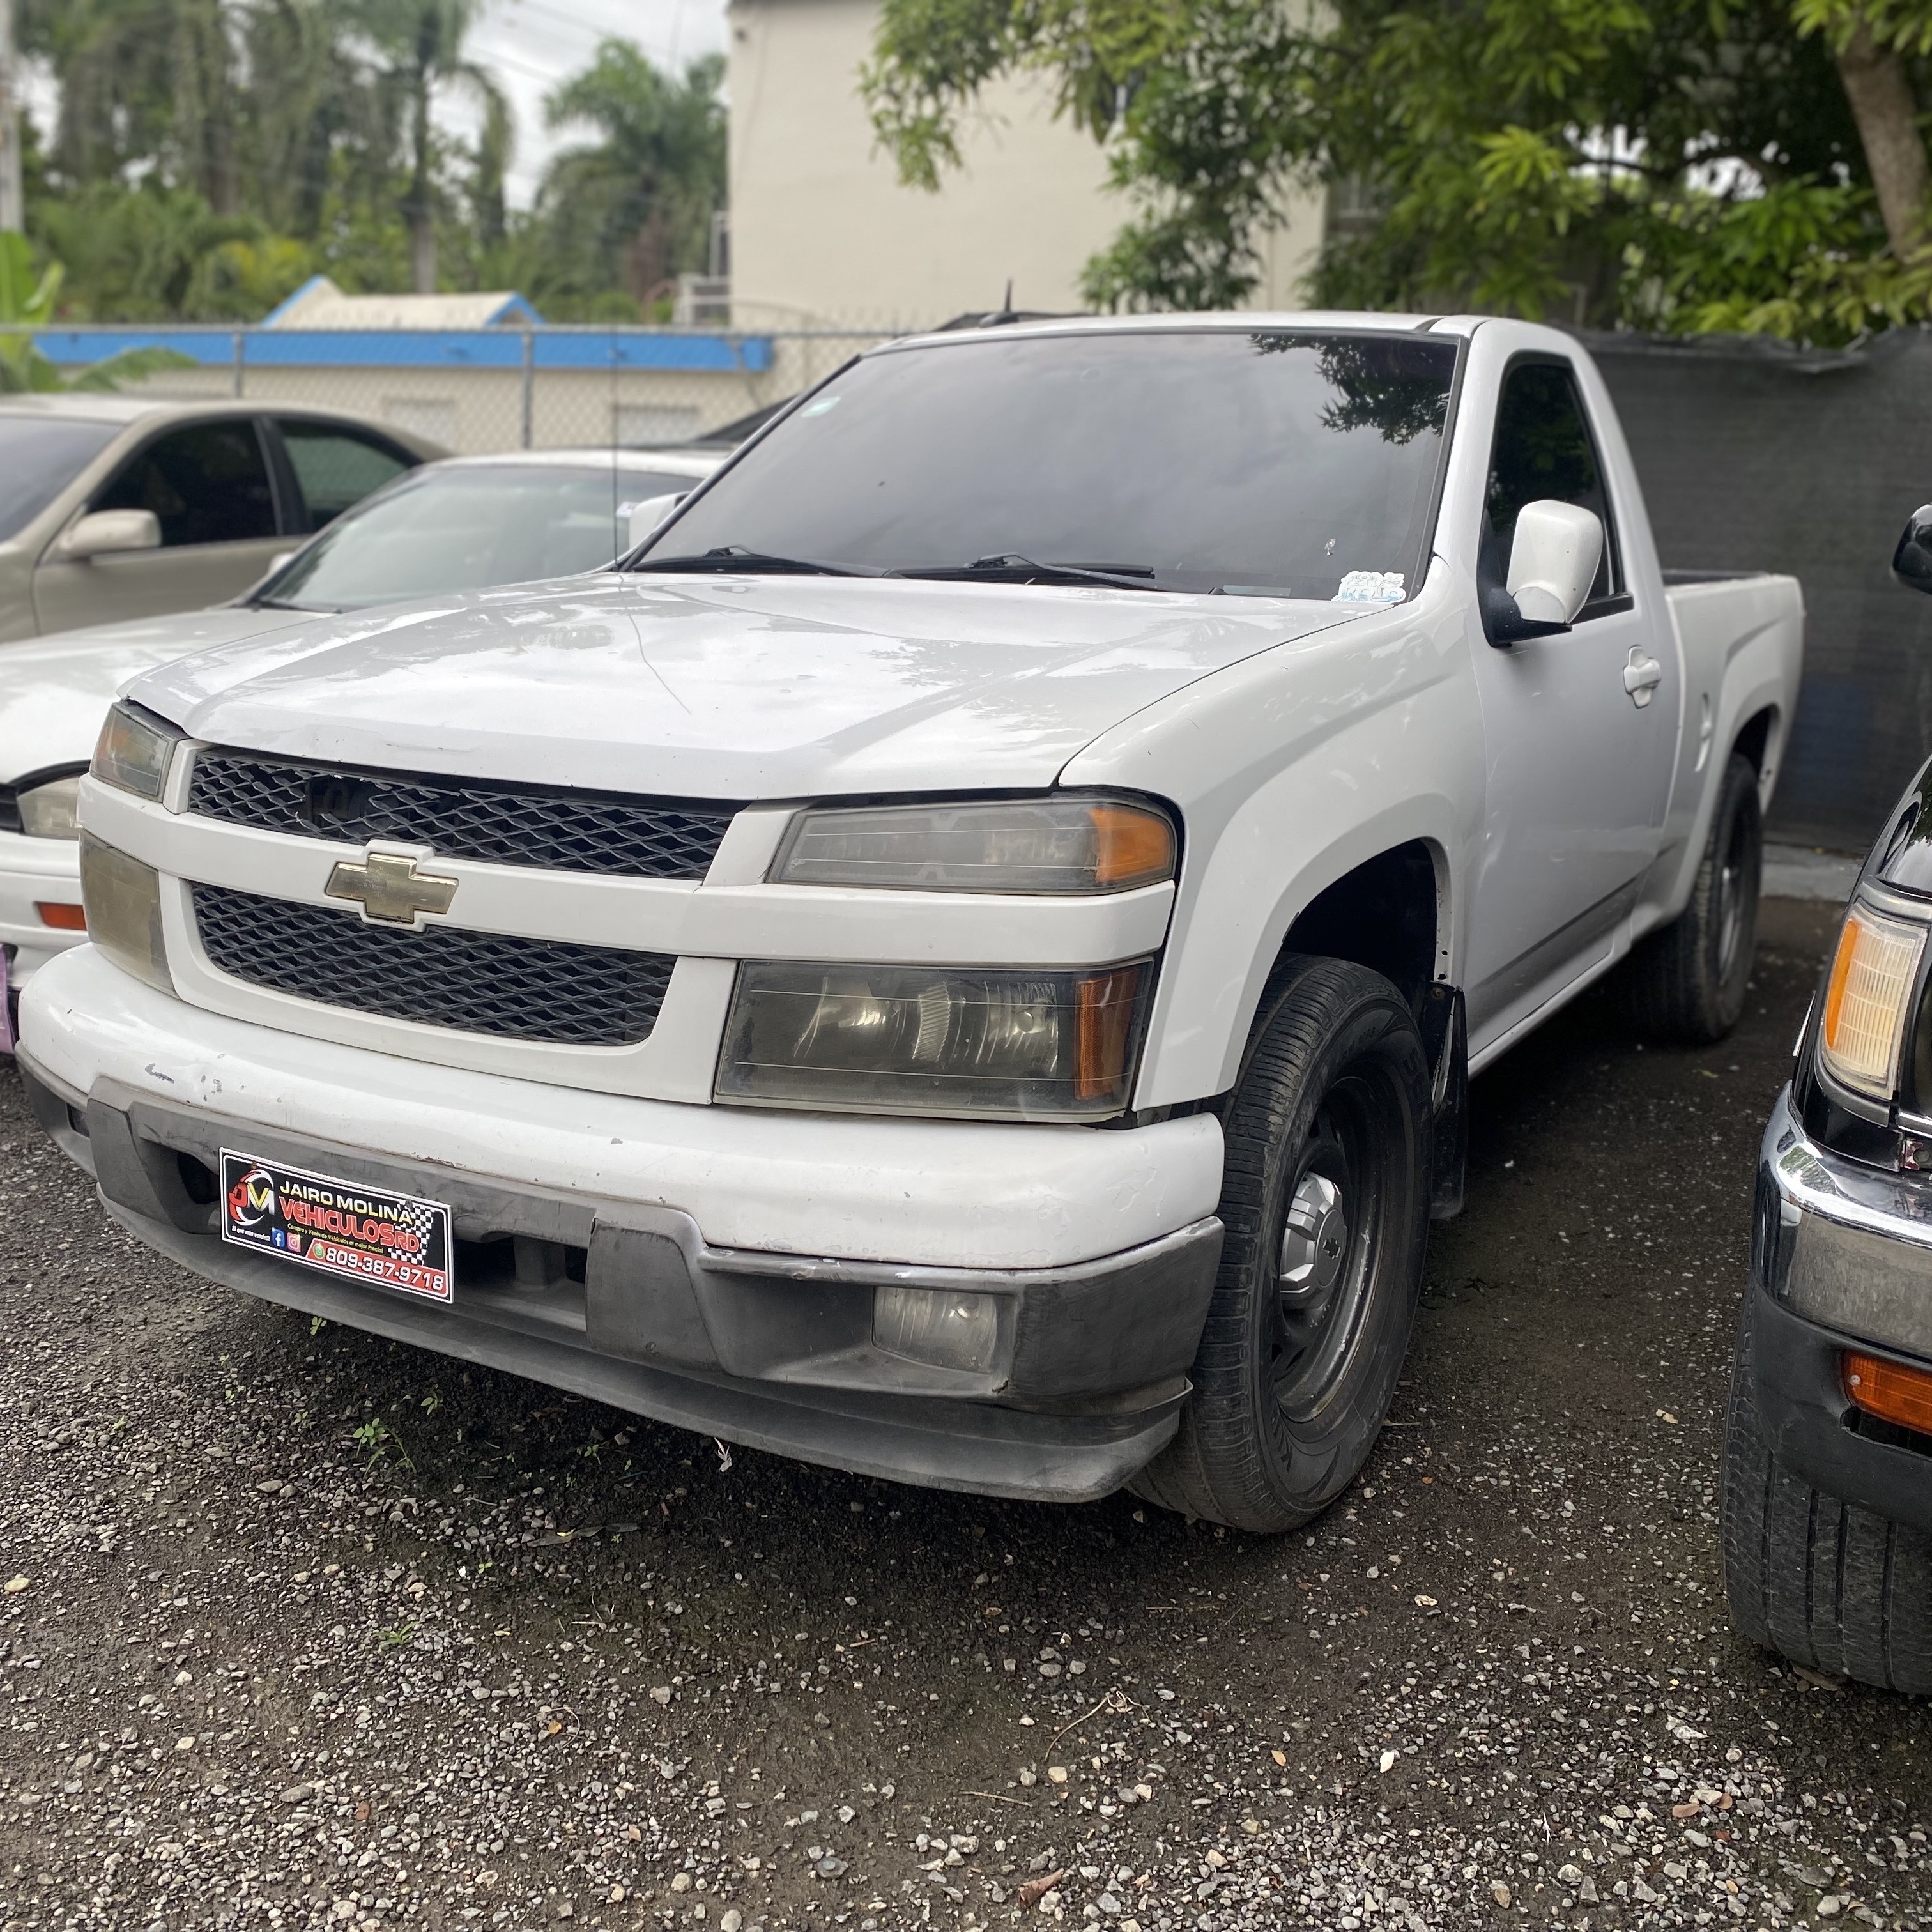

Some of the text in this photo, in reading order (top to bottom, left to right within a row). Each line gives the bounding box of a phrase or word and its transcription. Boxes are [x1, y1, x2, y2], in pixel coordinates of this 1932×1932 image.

[280, 1181, 413, 1225] JAIRO MOLINA
[326, 1247, 445, 1291] 809-387-9718
